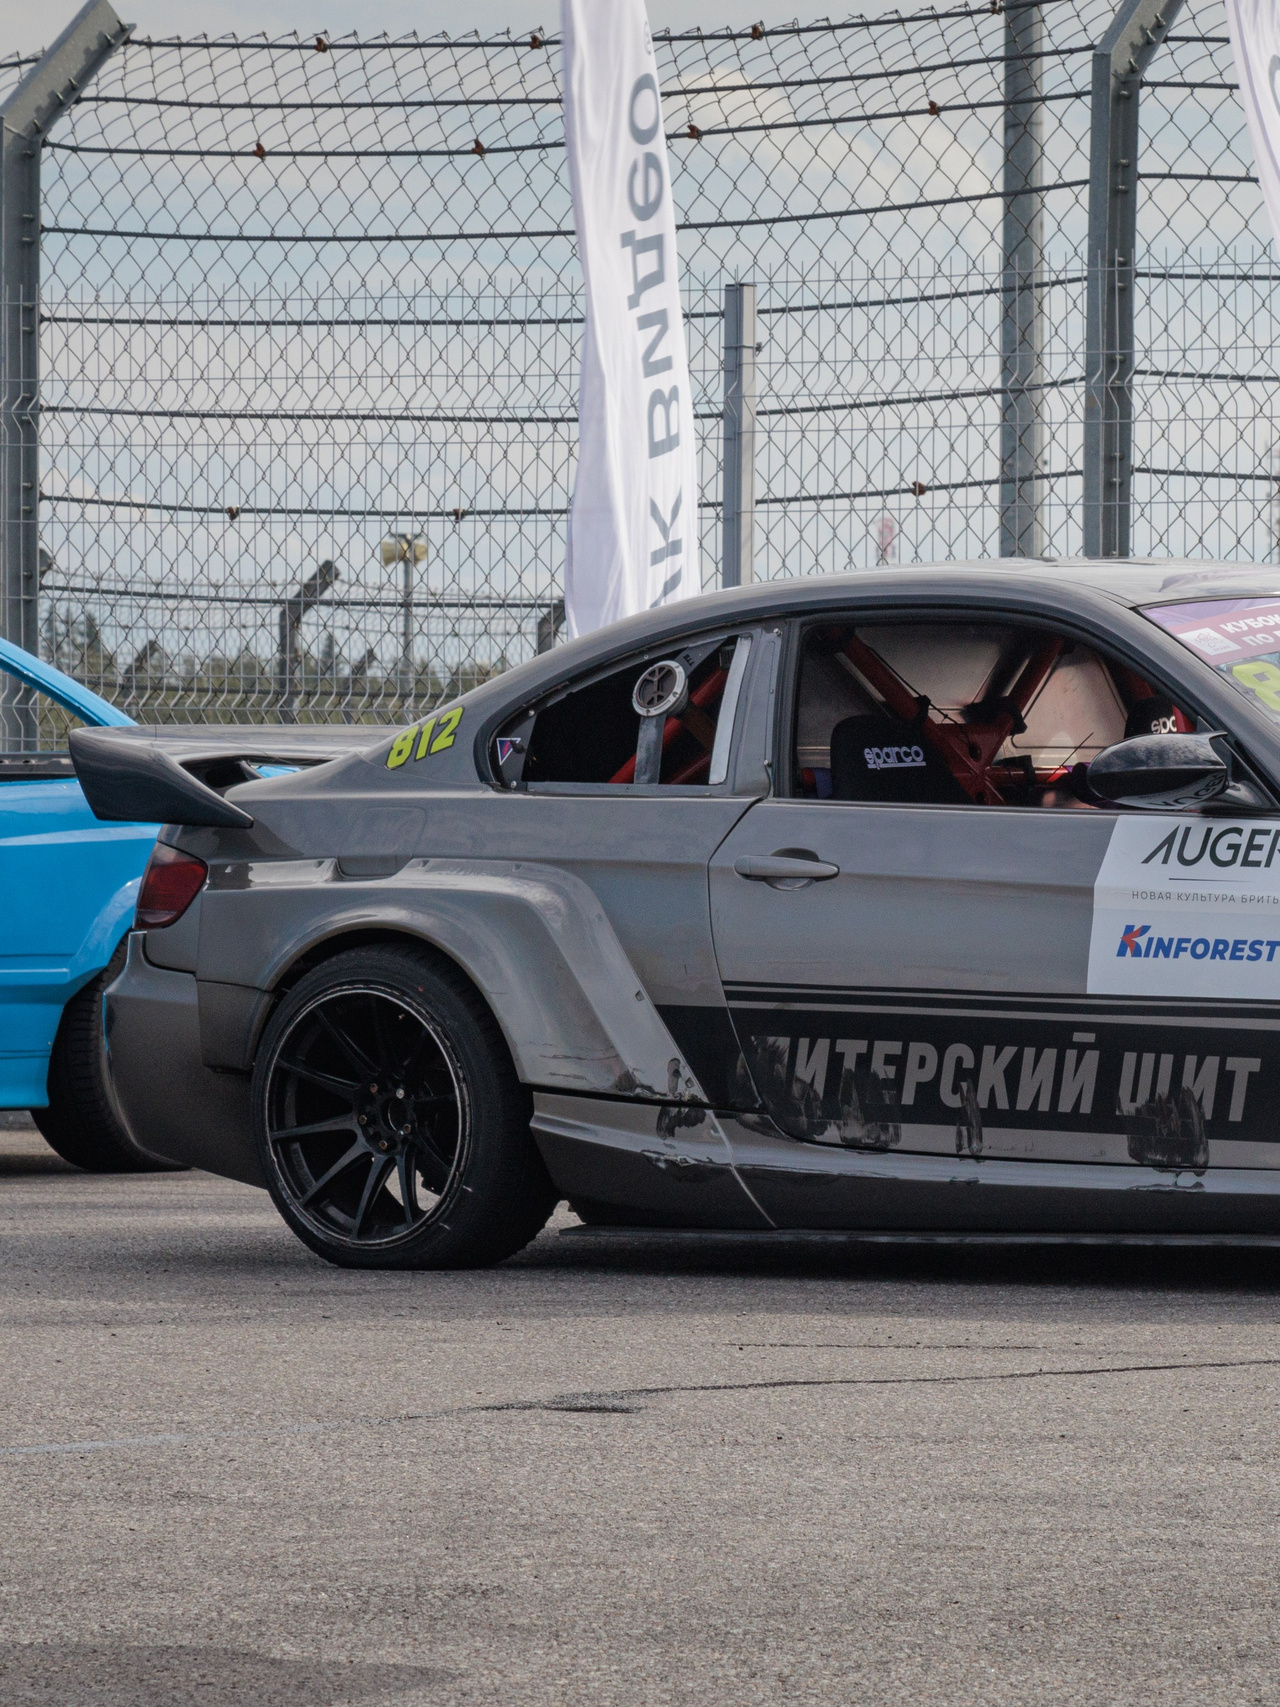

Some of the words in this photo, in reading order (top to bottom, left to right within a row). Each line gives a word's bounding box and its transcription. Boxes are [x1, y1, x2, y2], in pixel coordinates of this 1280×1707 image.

[1241, 632, 1275, 646] ПО
[385, 705, 465, 770] 812
[864, 746, 925, 770] sparco
[1131, 890, 1172, 901] НОВАЯ
[1176, 892, 1236, 903] КУЛЬТУРА
